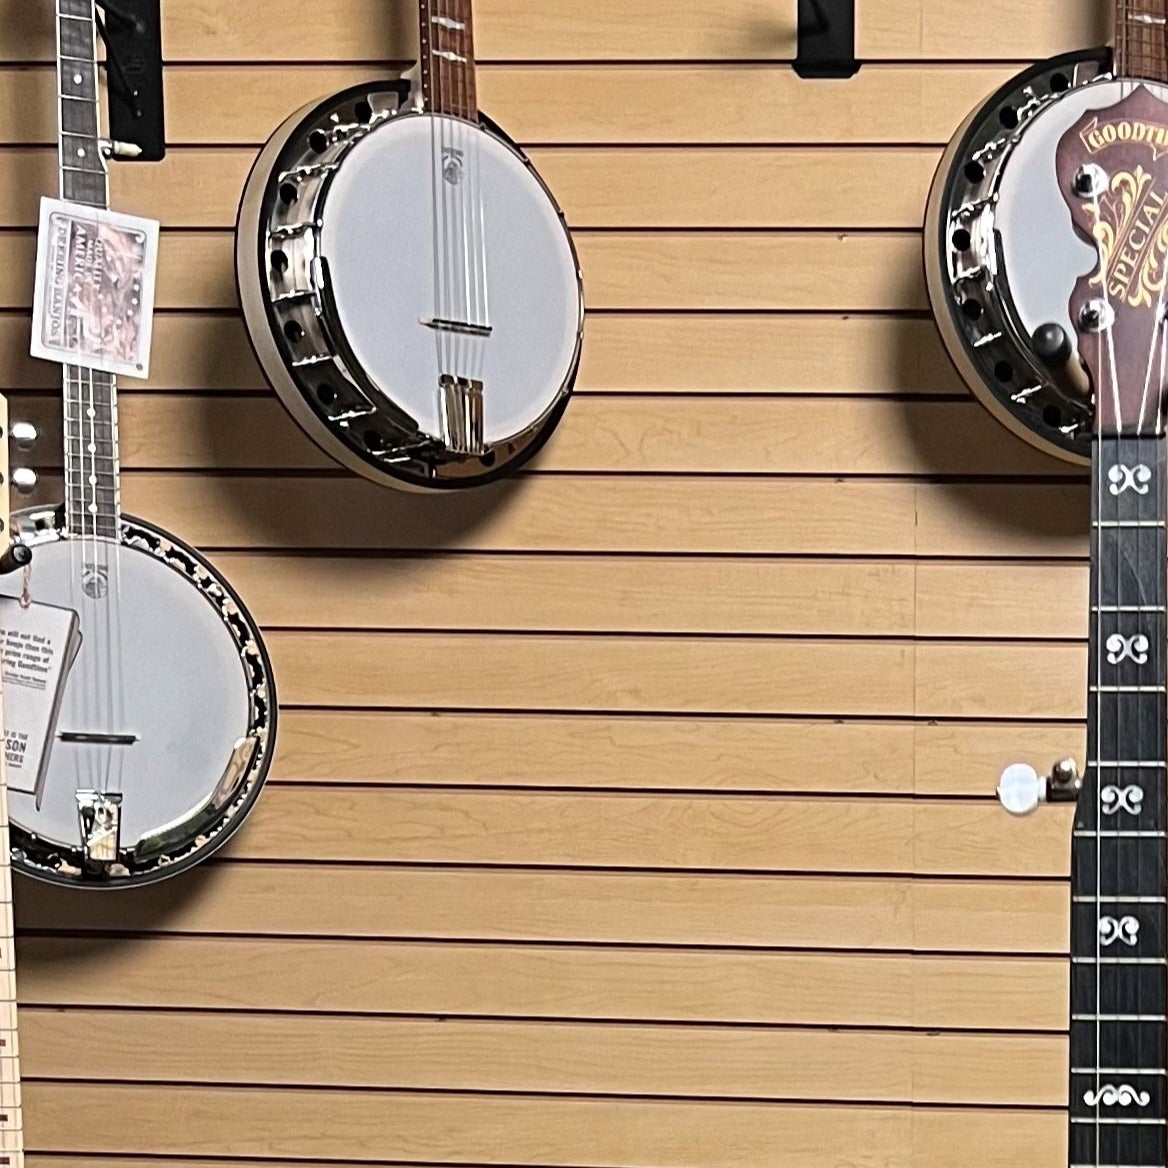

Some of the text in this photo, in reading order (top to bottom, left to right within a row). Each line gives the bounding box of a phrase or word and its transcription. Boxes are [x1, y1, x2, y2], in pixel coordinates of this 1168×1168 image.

[54, 226, 67, 286] DEERING
[1108, 190, 1165, 299] SPECIAL
[49, 287, 64, 337] BANJOS
[5, 738, 27, 753] SON
